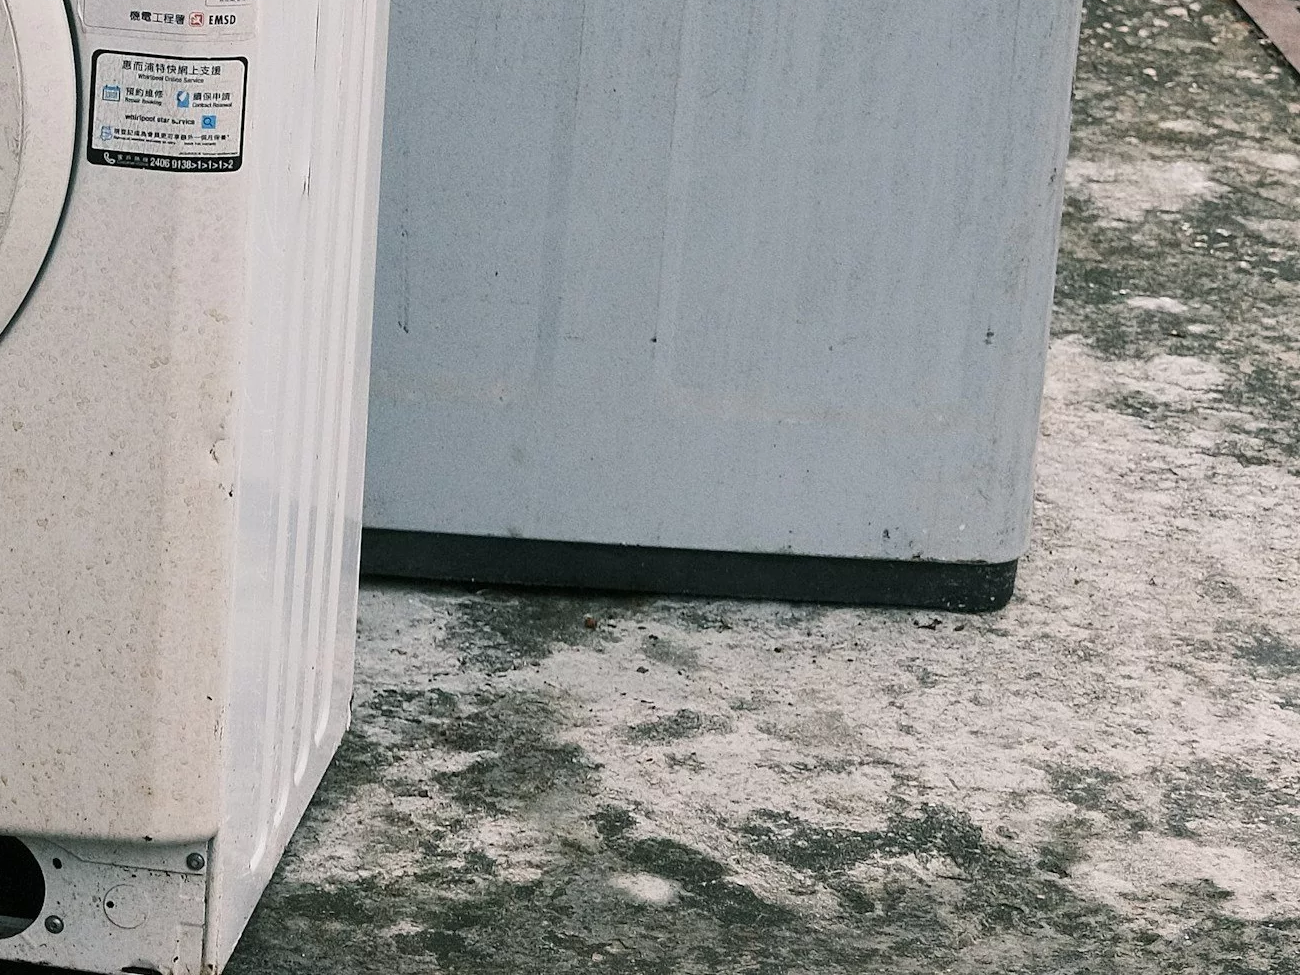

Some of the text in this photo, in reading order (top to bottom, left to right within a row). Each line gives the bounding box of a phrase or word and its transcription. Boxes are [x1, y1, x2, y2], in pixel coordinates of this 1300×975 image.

[130, 11, 236, 25] 機電工程署 EMSD
[150, 157, 170, 168] 2406
